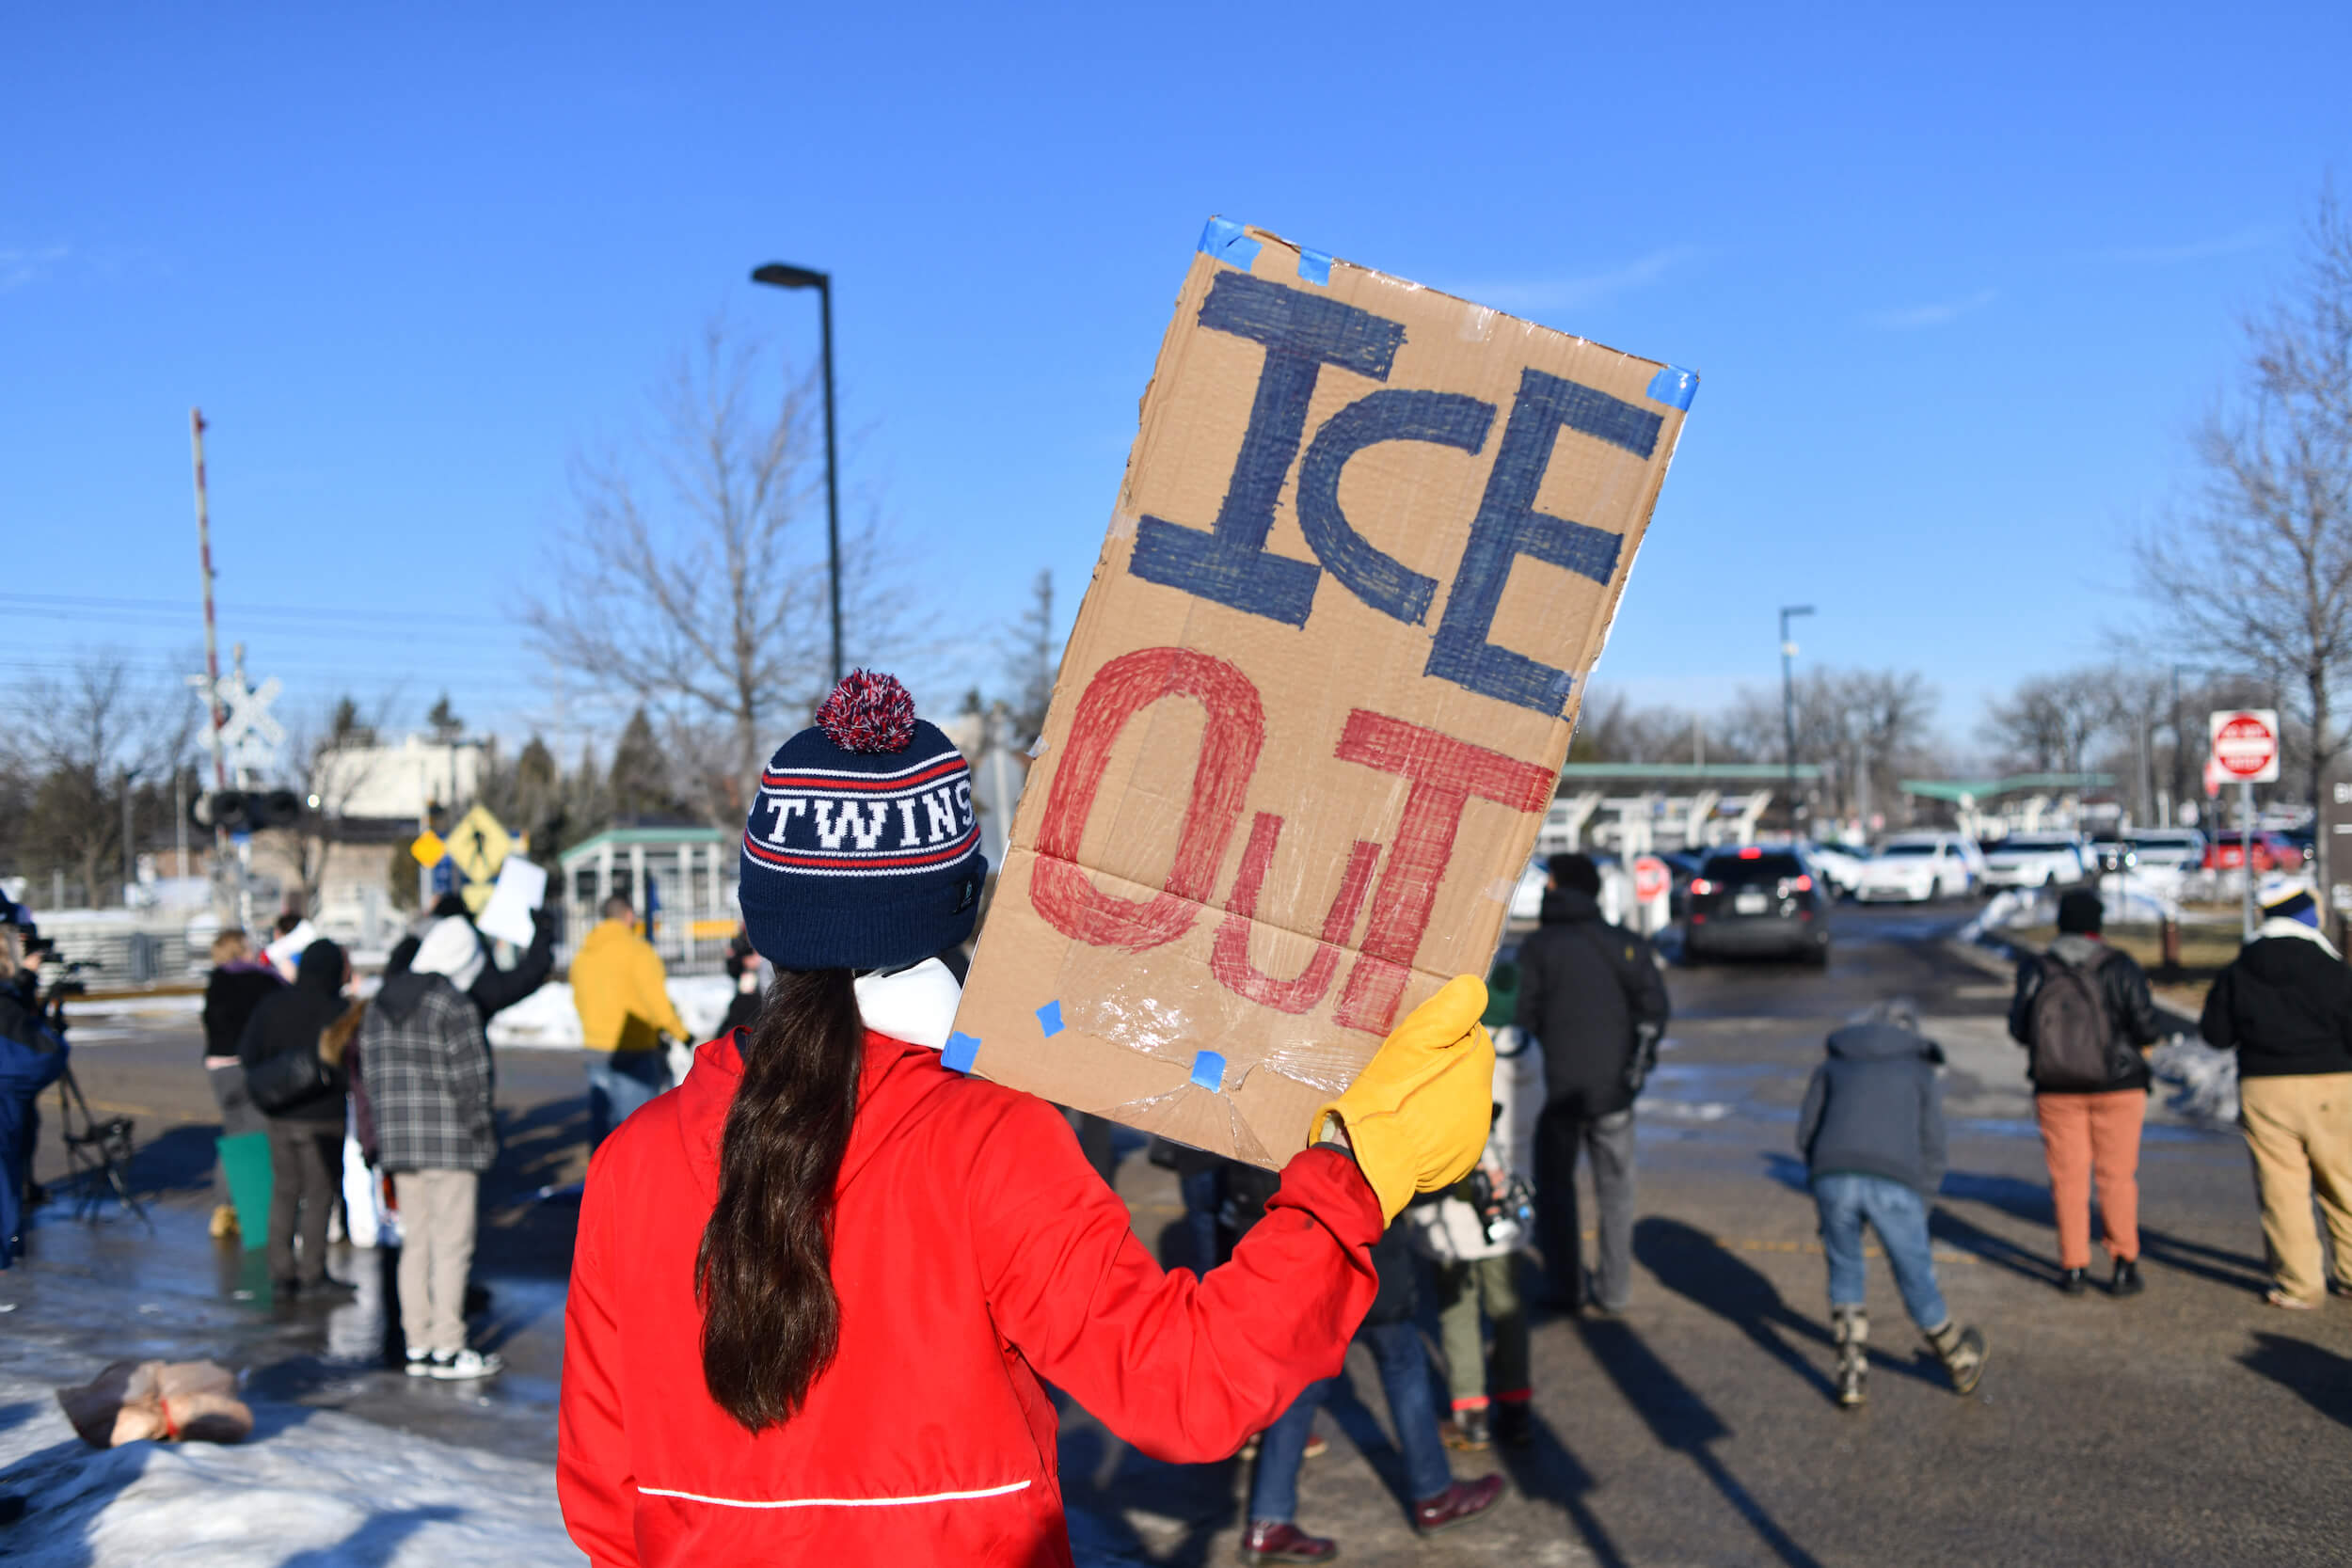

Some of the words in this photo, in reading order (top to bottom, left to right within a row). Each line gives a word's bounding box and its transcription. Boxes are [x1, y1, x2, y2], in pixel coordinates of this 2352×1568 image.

[1129, 269, 1665, 722] ICE
[766, 780, 974, 850] TWINS
[1026, 645, 1556, 1037] OUT
